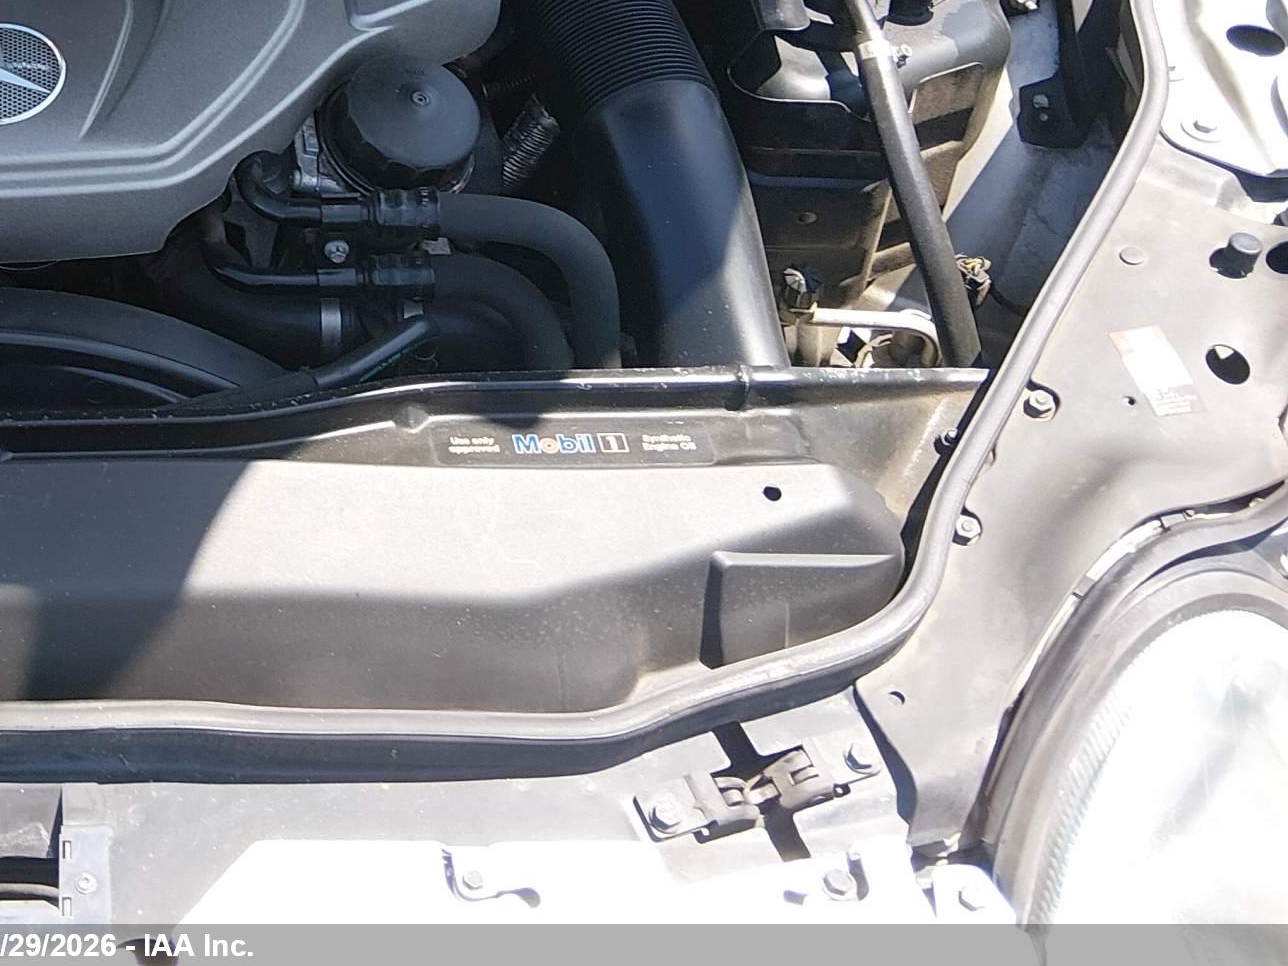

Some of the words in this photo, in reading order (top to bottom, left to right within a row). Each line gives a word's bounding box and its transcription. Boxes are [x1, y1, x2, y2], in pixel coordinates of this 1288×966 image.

[449, 436, 471, 445] Use
[471, 436, 495, 446] only
[511, 433, 596, 454] Mobil
[448, 443, 501, 454] approved
[642, 442, 679, 452] Engine
